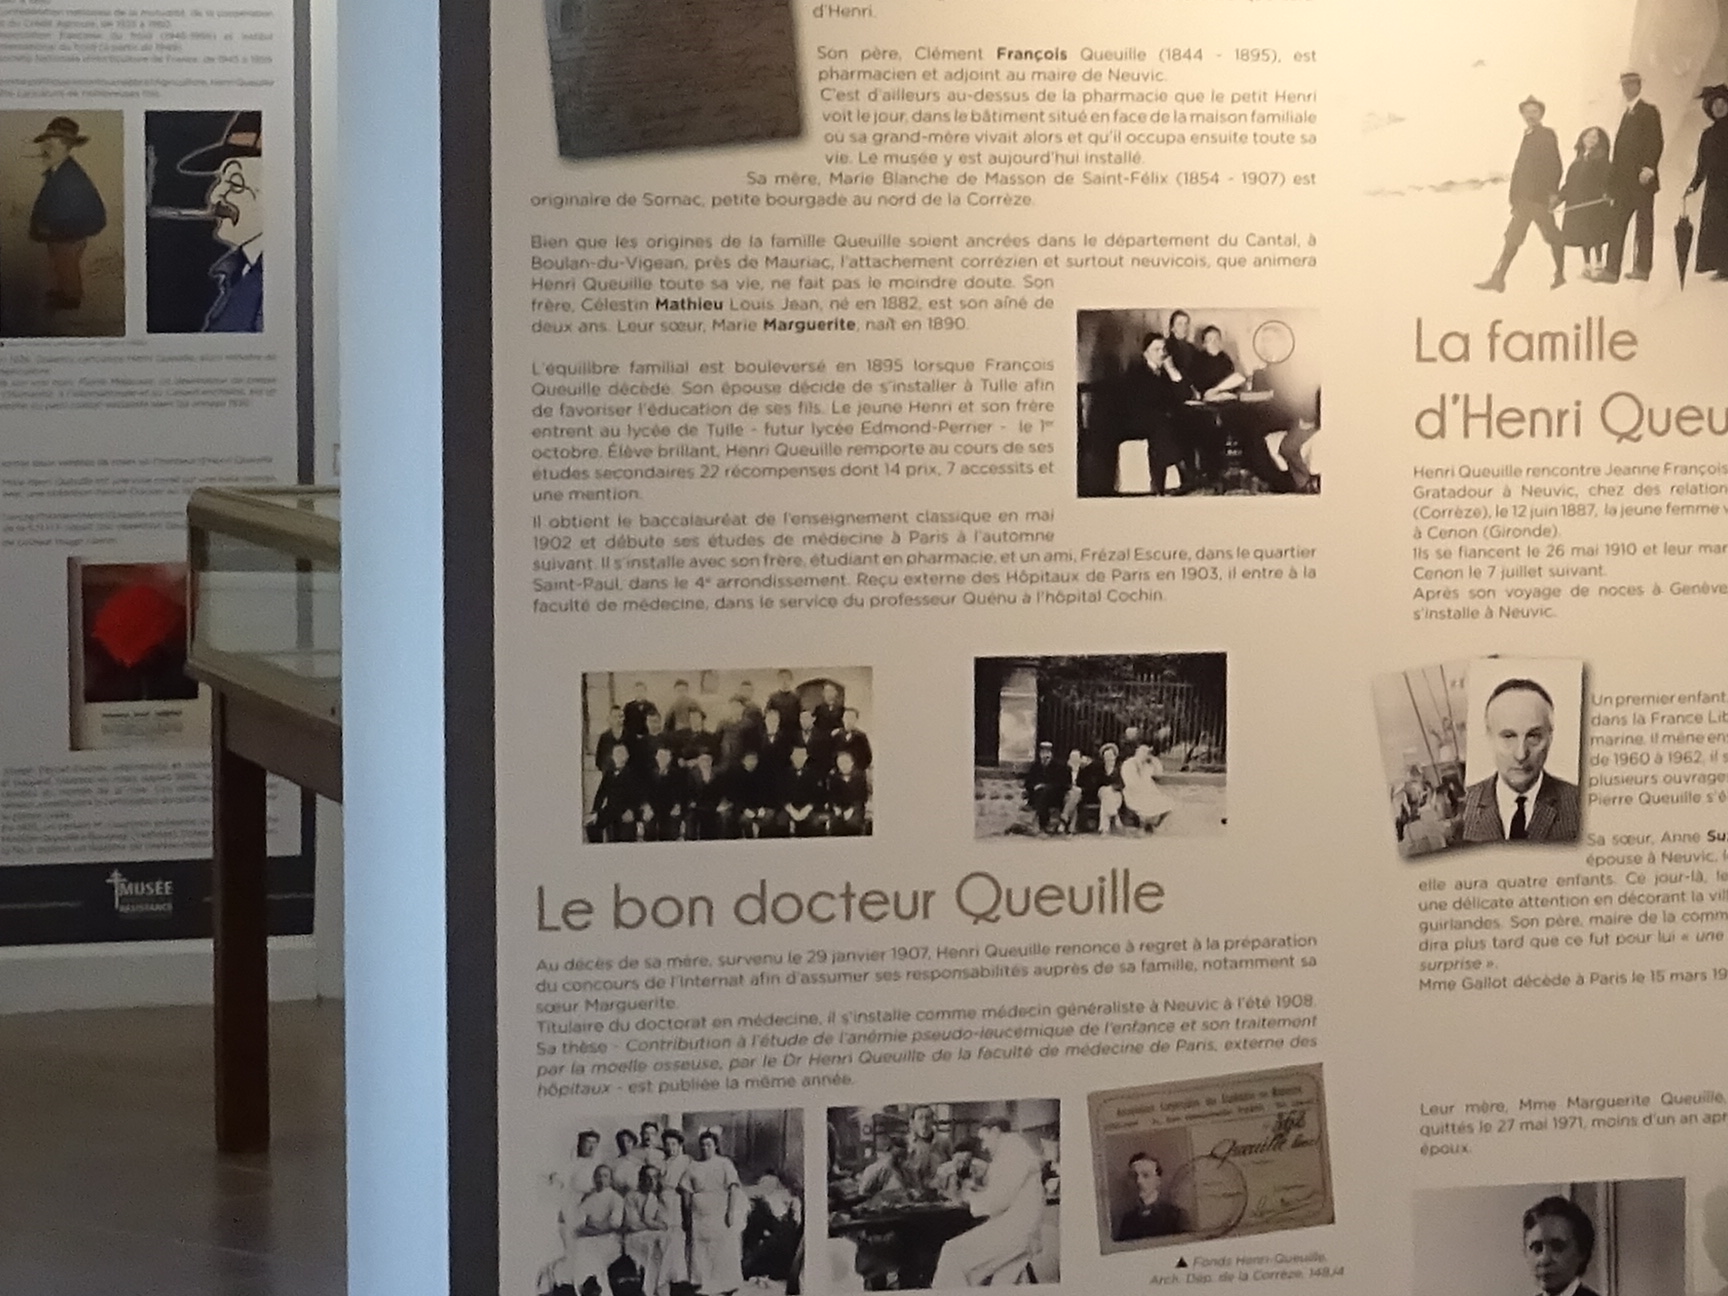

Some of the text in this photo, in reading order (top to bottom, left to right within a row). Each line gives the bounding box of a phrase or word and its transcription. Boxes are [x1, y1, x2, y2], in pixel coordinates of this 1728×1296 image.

[816, 45, 849, 60] Son
[914, 45, 984, 62] Clément
[996, 46, 1068, 64] François
[1079, 46, 1147, 62] Queuille
[1158, 47, 1203, 63] (1844
[1293, 49, 1317, 63] est
[817, 65, 917, 83] pharmacien
[921, 67, 938, 82] et
[943, 66, 1001, 84] adjoint
[1005, 70, 1026, 83] au
[1030, 70, 1078, 83] maire
[1081, 67, 1103, 83] de
[531, 319, 572, 334] deux
[617, 320, 654, 334] Leur
[711, 318, 758, 332] Marie
[865, 316, 896, 331] naît
[900, 319, 922, 331] en
[1415, 315, 1639, 364] La famille
[1414, 392, 1582, 441] d'Henri
[1413, 465, 1456, 480] Henri
[1458, 464, 1523, 479] Queuille
[1525, 464, 1602, 478] rencontre
[1604, 463, 1661, 477] Jeanne
[1502, 484, 1512, 499] à
[1587, 483, 1625, 498] chez
[1632, 481, 1662, 497] des
[1495, 503, 1509, 519] le
[1511, 504, 1528, 519] 12
[1529, 506, 1559, 521] juin
[1603, 502, 1618, 517] la
[1619, 504, 1663, 519] jeune
[1665, 501, 1721, 517] femme
[1412, 525, 1423, 541] à
[1426, 525, 1478, 541] Cenon
[119, 877, 173, 896] MUSÉE
[536, 866, 1166, 933] Le bon docteur Queuille
